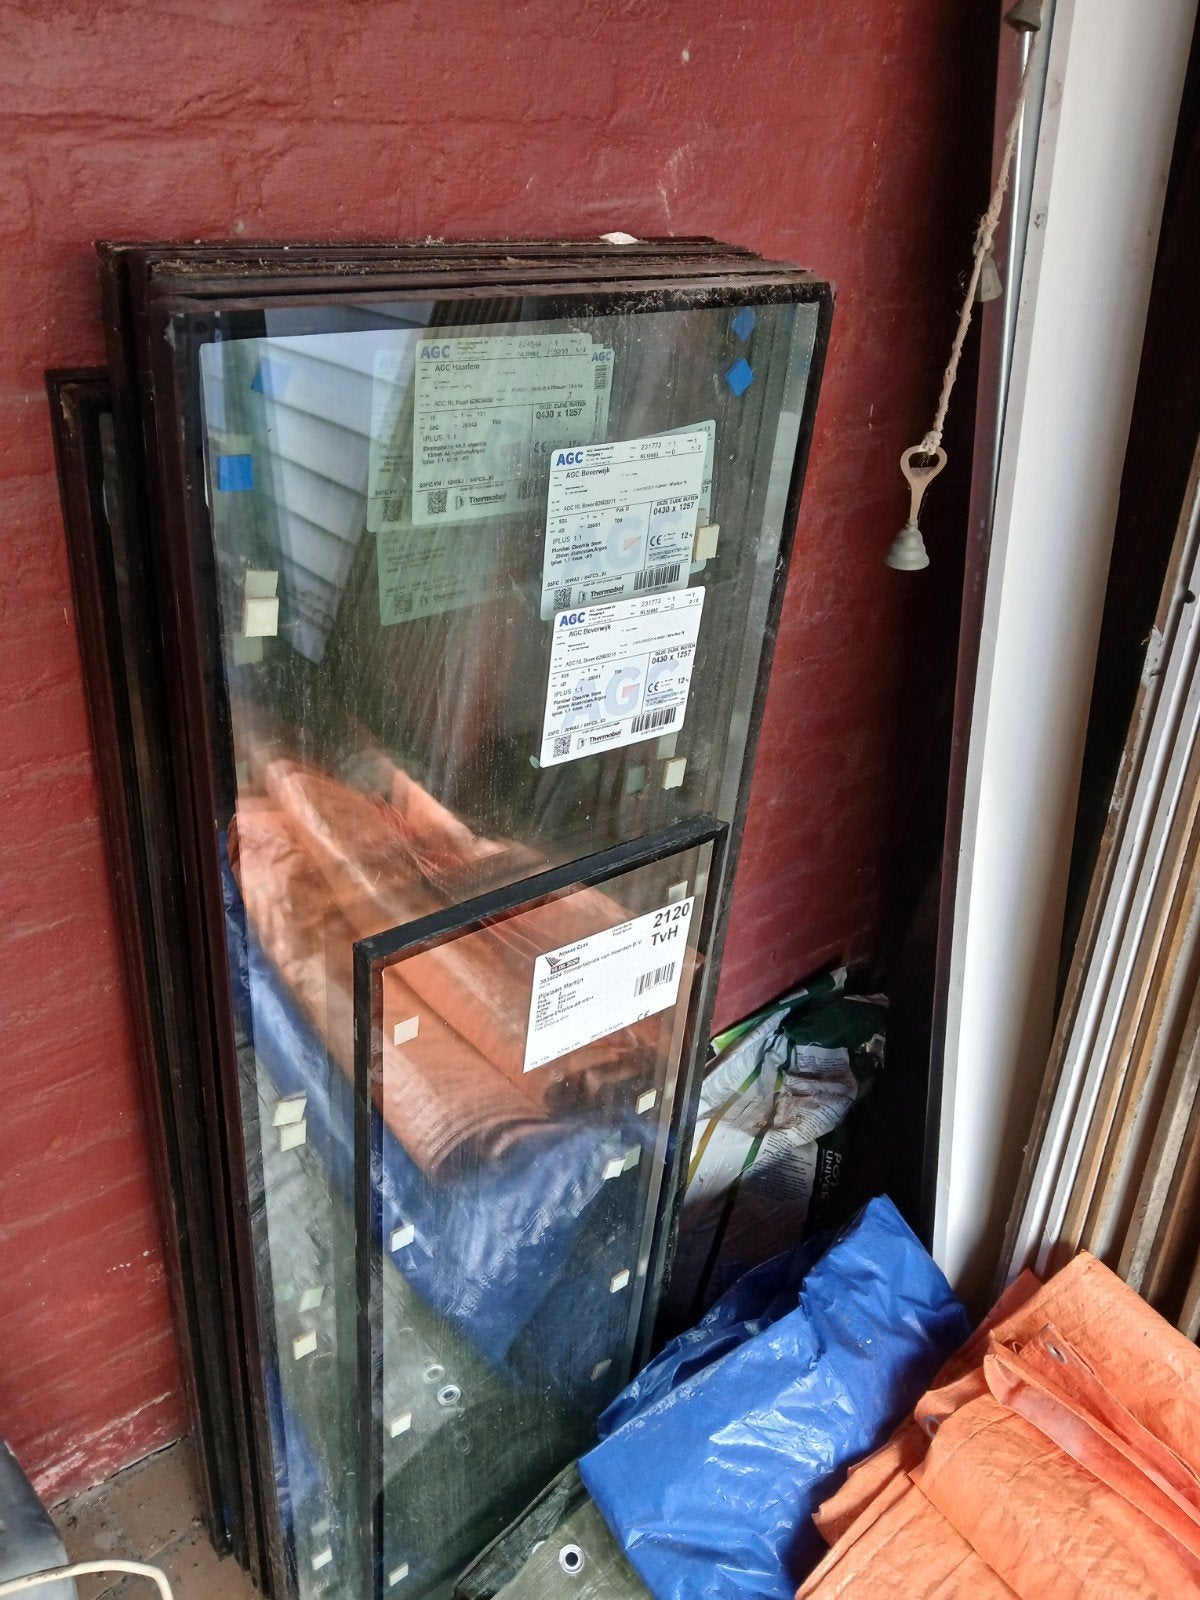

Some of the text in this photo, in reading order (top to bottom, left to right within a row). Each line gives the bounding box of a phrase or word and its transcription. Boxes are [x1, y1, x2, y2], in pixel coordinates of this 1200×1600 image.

[420, 344, 450, 360] AGC
[592, 351, 612, 362] AGC
[434, 364, 452, 372] AGC
[565, 407, 583, 417] 1257
[556, 451, 584, 467] AGC
[565, 466, 611, 479] AGC Beverwijk
[653, 506, 671, 516] 0430
[680, 502, 696, 511] 1257
[560, 611, 587, 628] AGC
[568, 630, 583, 638] AGC
[651, 655, 669, 665] 0430
[677, 649, 692, 659] 1257
[652, 901, 691, 928] 2120
[651, 924, 679, 946] TvH
